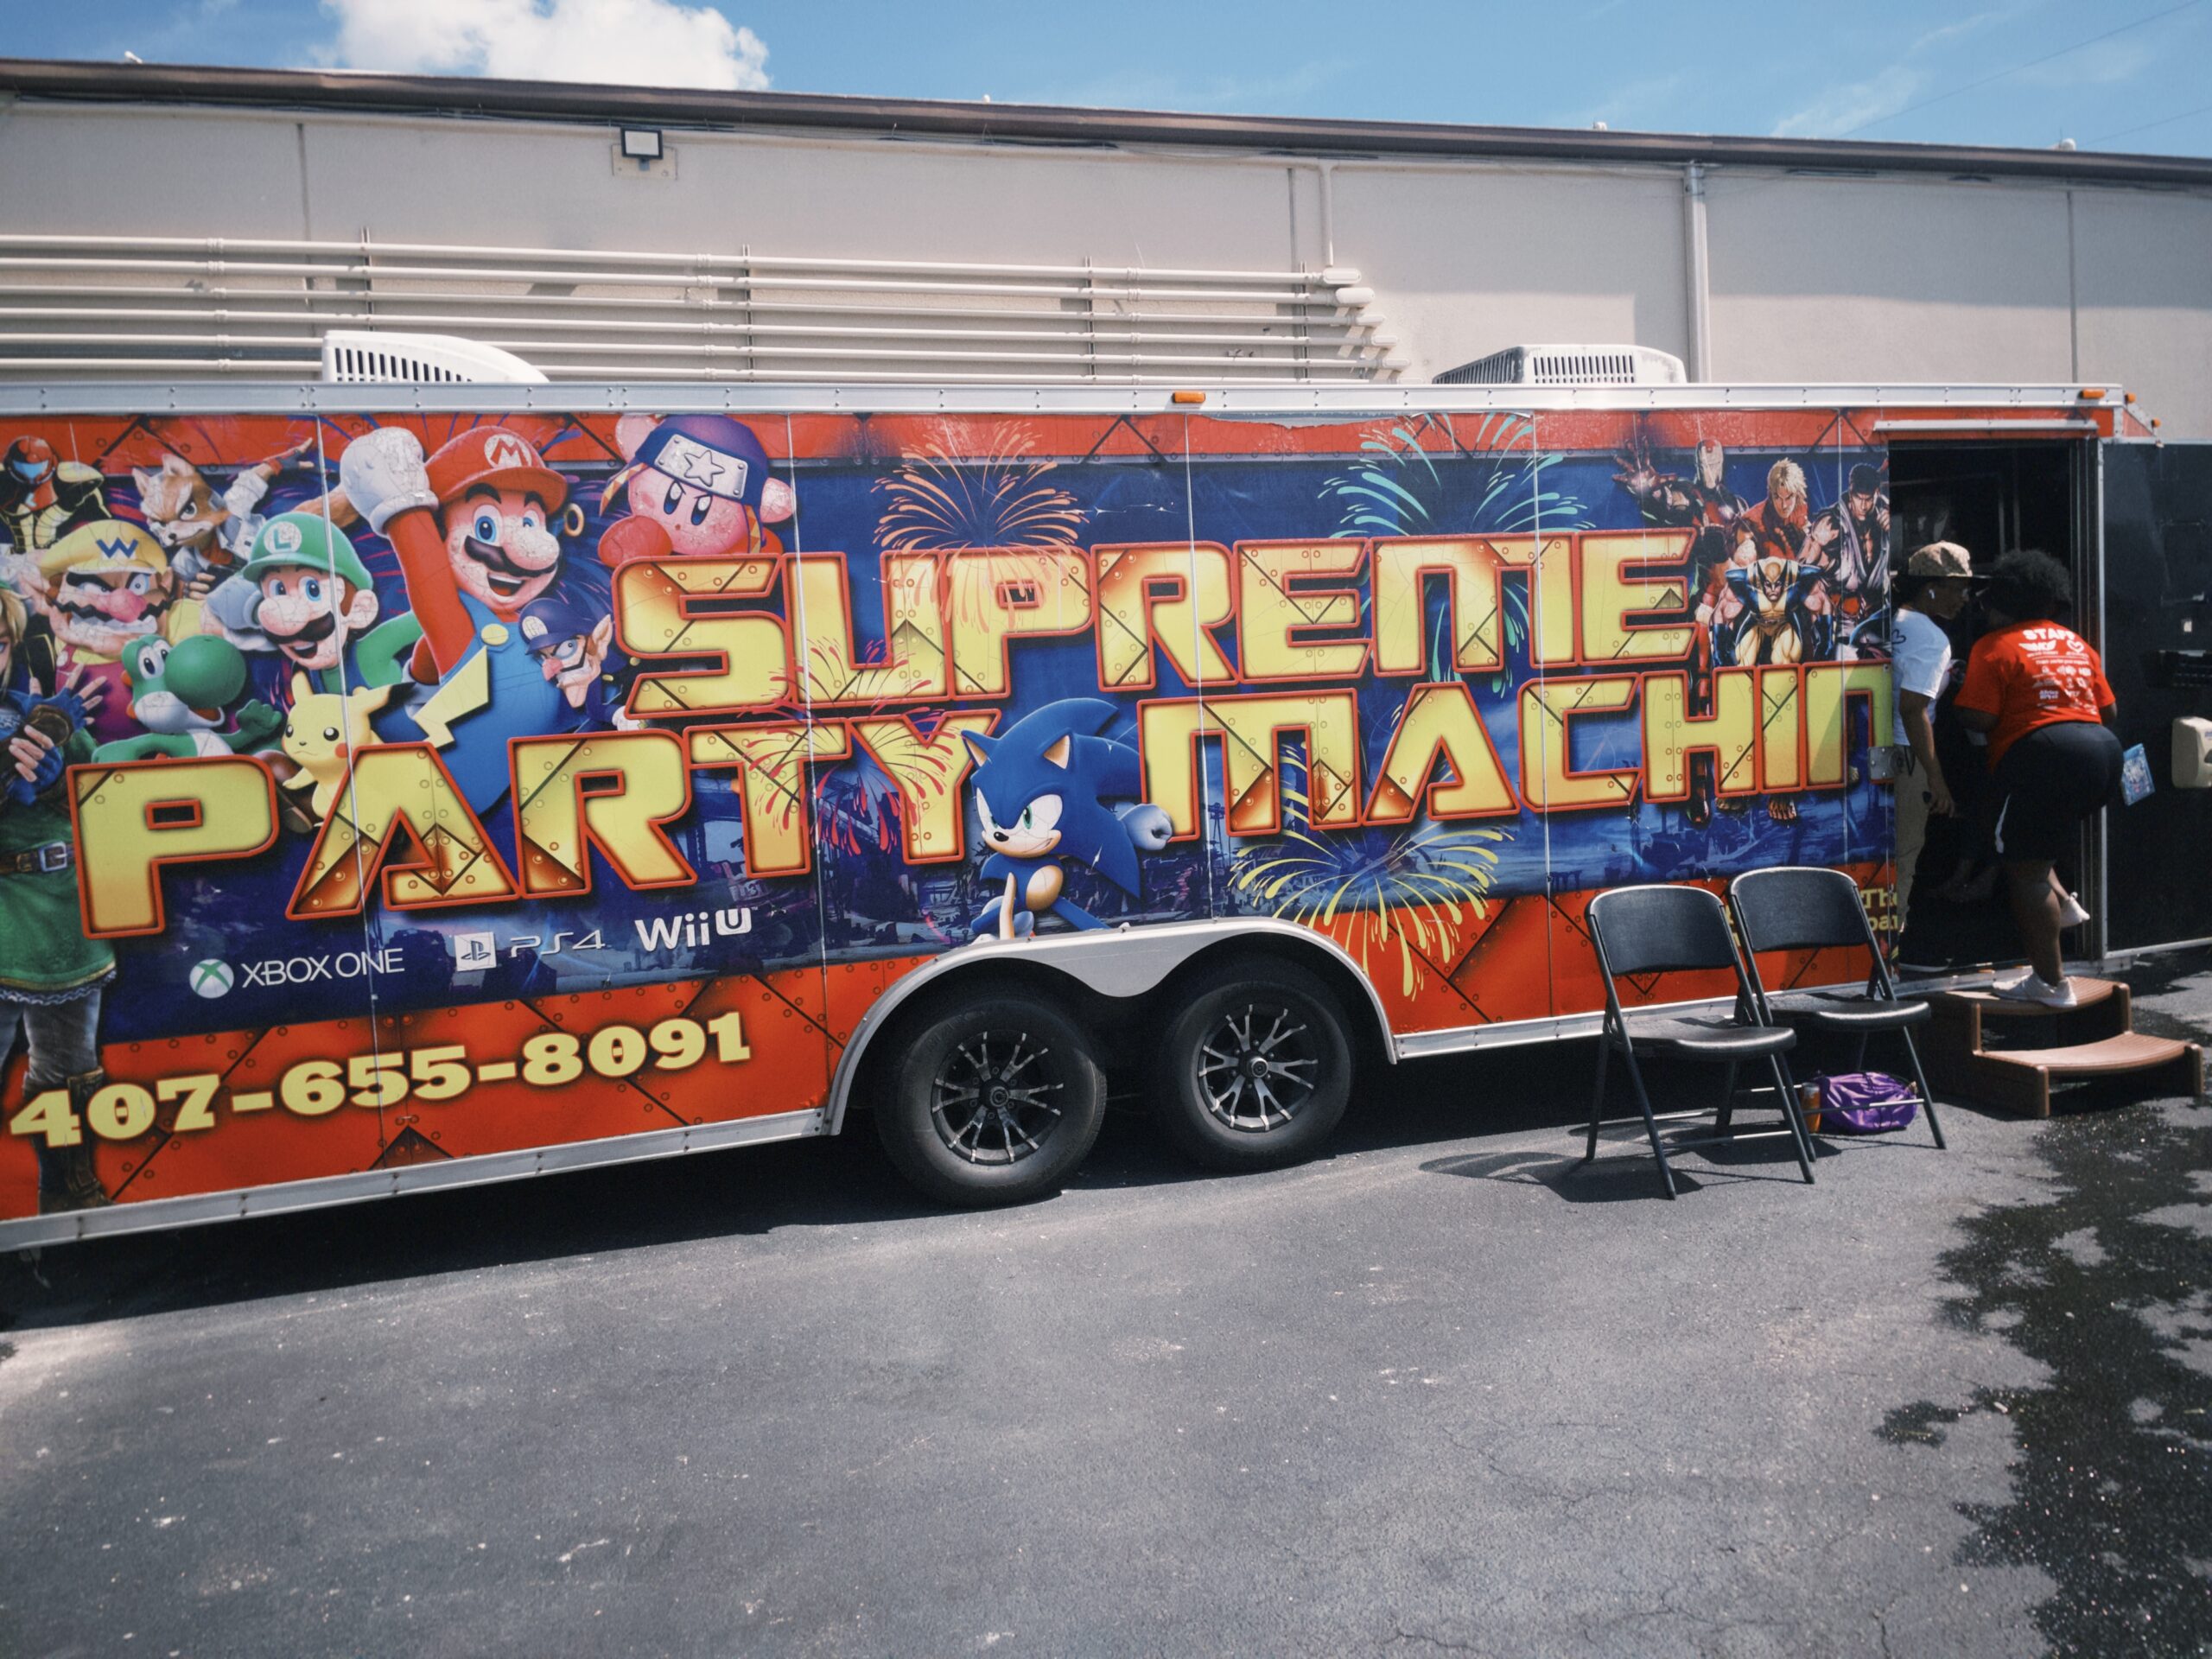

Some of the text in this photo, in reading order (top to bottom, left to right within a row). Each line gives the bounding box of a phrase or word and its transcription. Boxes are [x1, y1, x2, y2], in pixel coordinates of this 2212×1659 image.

[492, 438, 529, 467] M
[95, 538, 138, 558] W
[272, 525, 294, 550] L
[613, 528, 1699, 719] SUPREME
[66, 709, 1002, 940] PARTY
[510, 929, 606, 958] PS4
[240, 947, 405, 988] XBOX ONE
[10, 1011, 752, 1149] 407-655-8091
